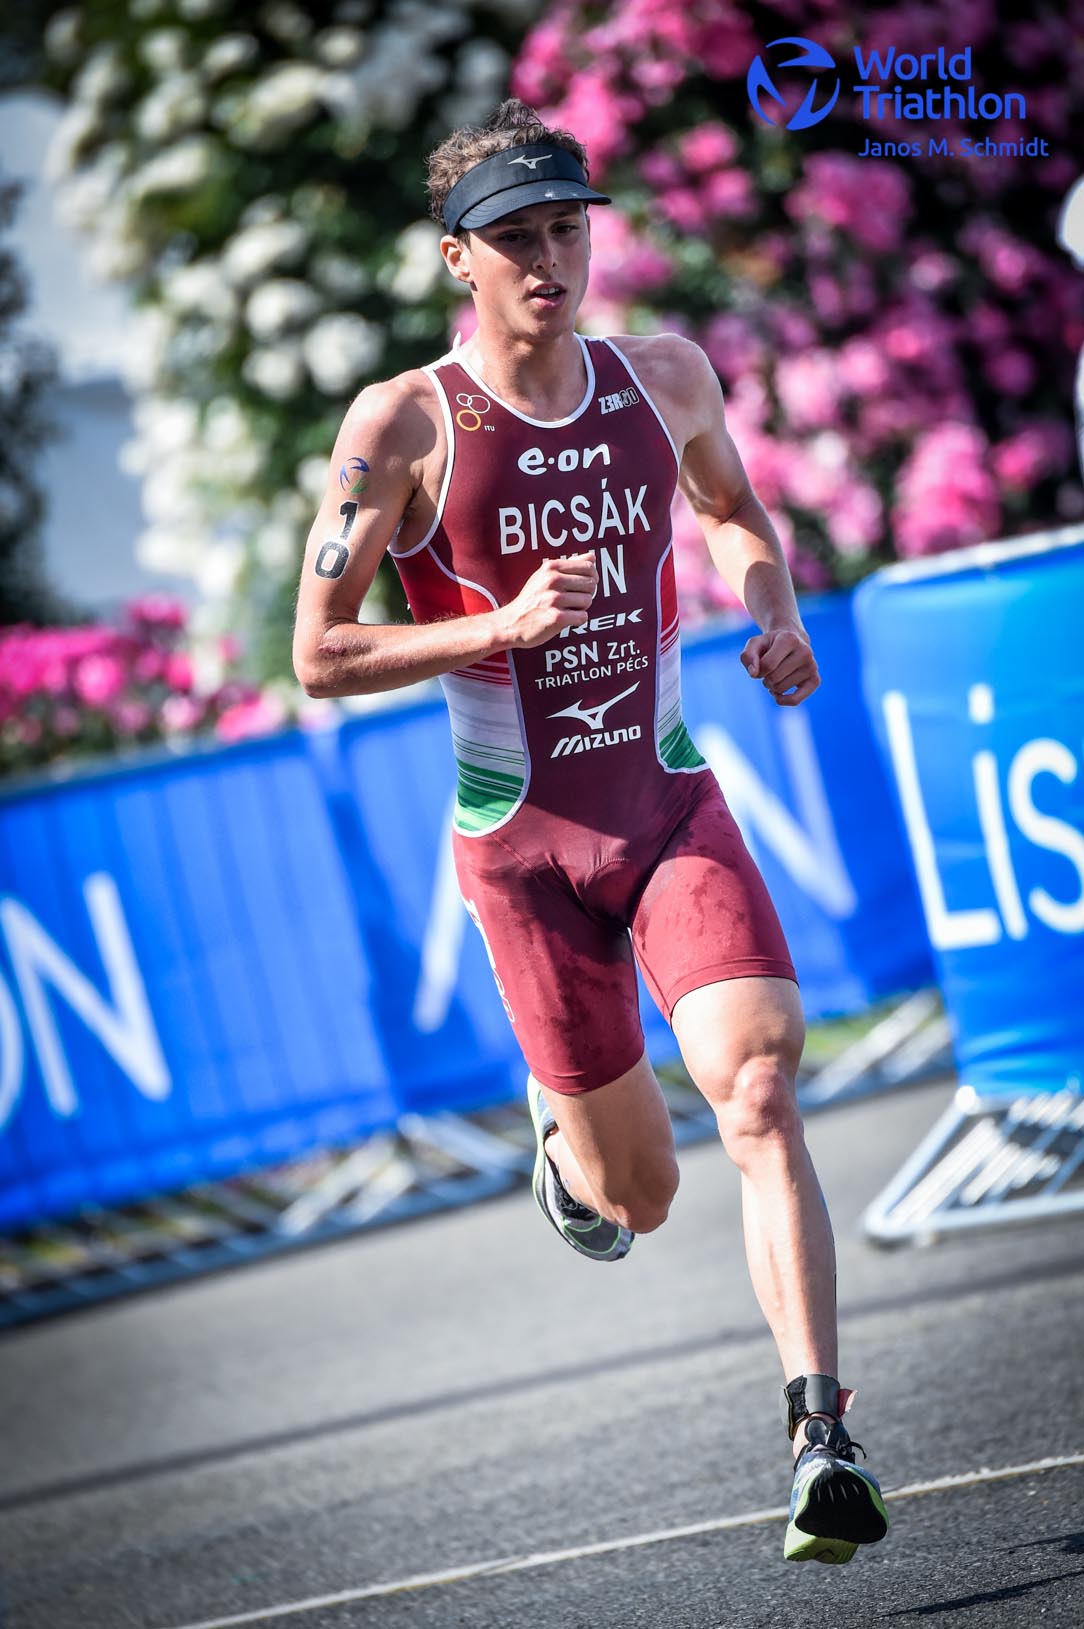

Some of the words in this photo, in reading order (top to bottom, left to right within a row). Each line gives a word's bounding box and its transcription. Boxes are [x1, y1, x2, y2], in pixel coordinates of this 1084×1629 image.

[498, 478, 651, 555] BICSÁK
[559, 608, 644, 638] REK
[535, 665, 612, 690] TRIATLON
[616, 655, 649, 674] PÉCS
[545, 641, 599, 672] PSN
[607, 639, 640, 660] Zrt.
